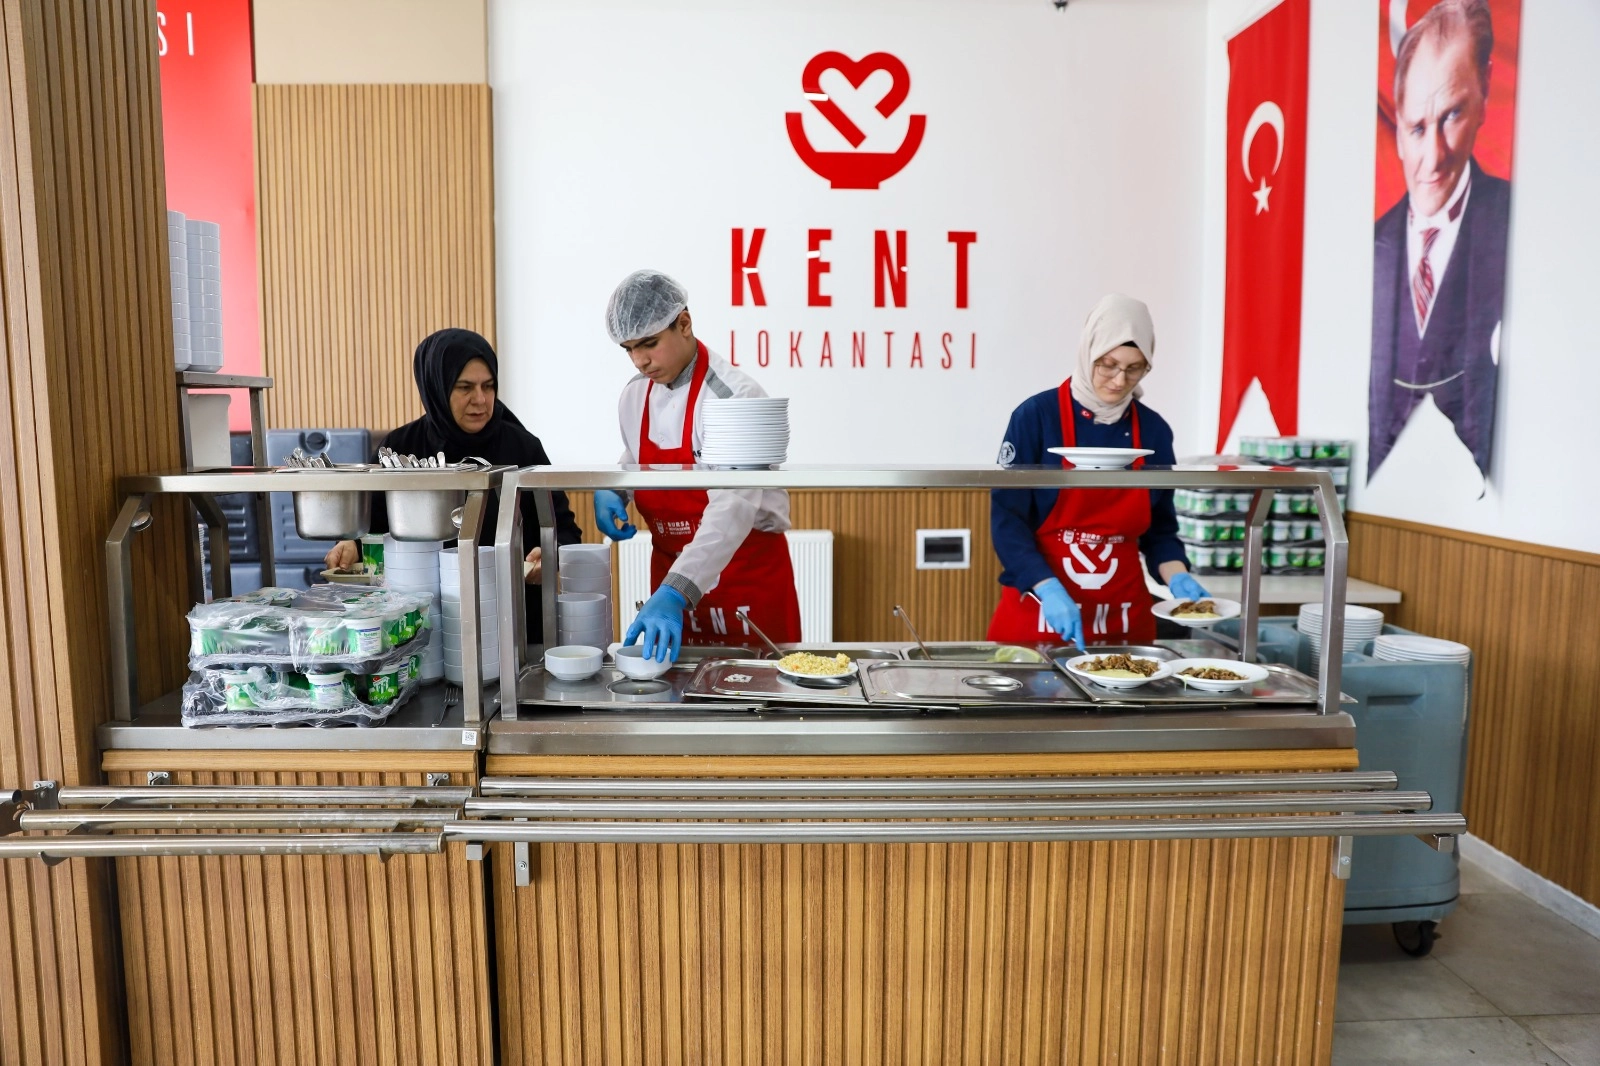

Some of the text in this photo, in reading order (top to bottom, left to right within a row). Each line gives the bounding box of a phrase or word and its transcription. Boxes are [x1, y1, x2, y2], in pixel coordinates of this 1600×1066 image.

[731, 228, 977, 309] KENT
[730, 329, 976, 370] LOKANTASI
[688, 605, 751, 636] ENT
[1037, 601, 1132, 635] KNT
